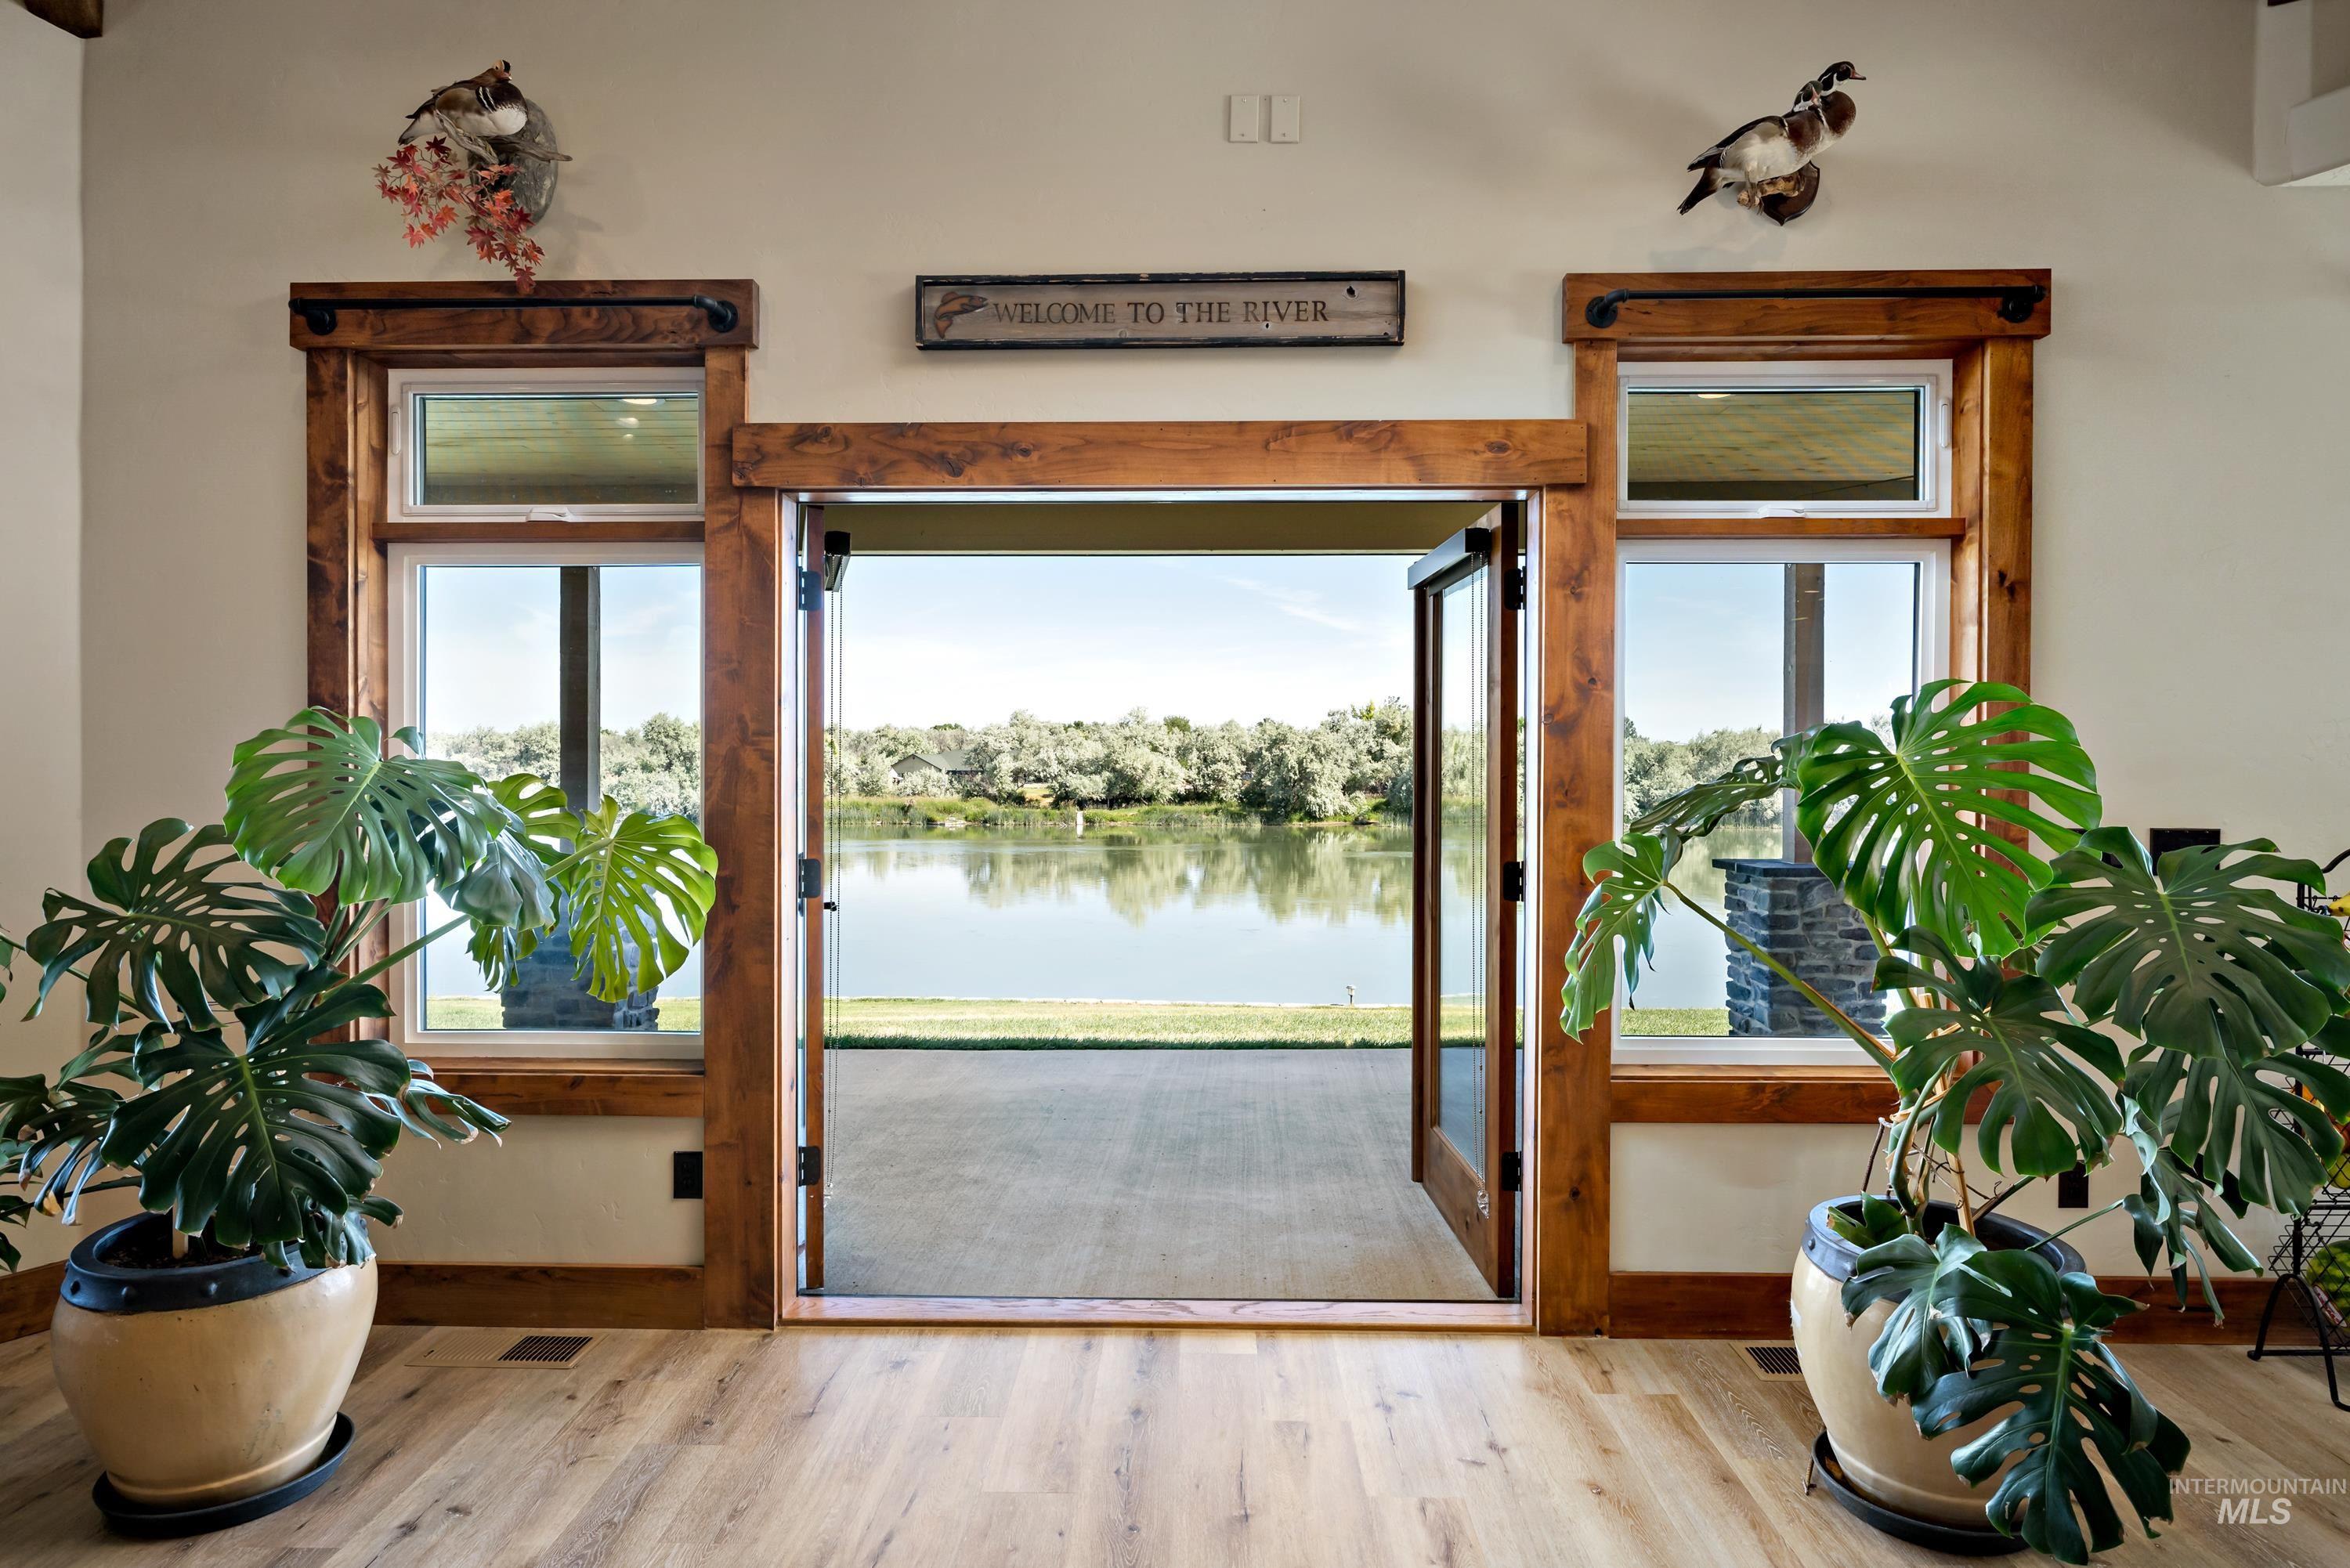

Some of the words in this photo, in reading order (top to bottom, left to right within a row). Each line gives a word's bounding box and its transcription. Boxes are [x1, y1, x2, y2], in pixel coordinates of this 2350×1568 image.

[992, 302, 1115, 324] WELCOME
[1127, 302, 1165, 324] TO
[1176, 302, 1231, 323] THE
[1242, 300, 1330, 323] RIVER
